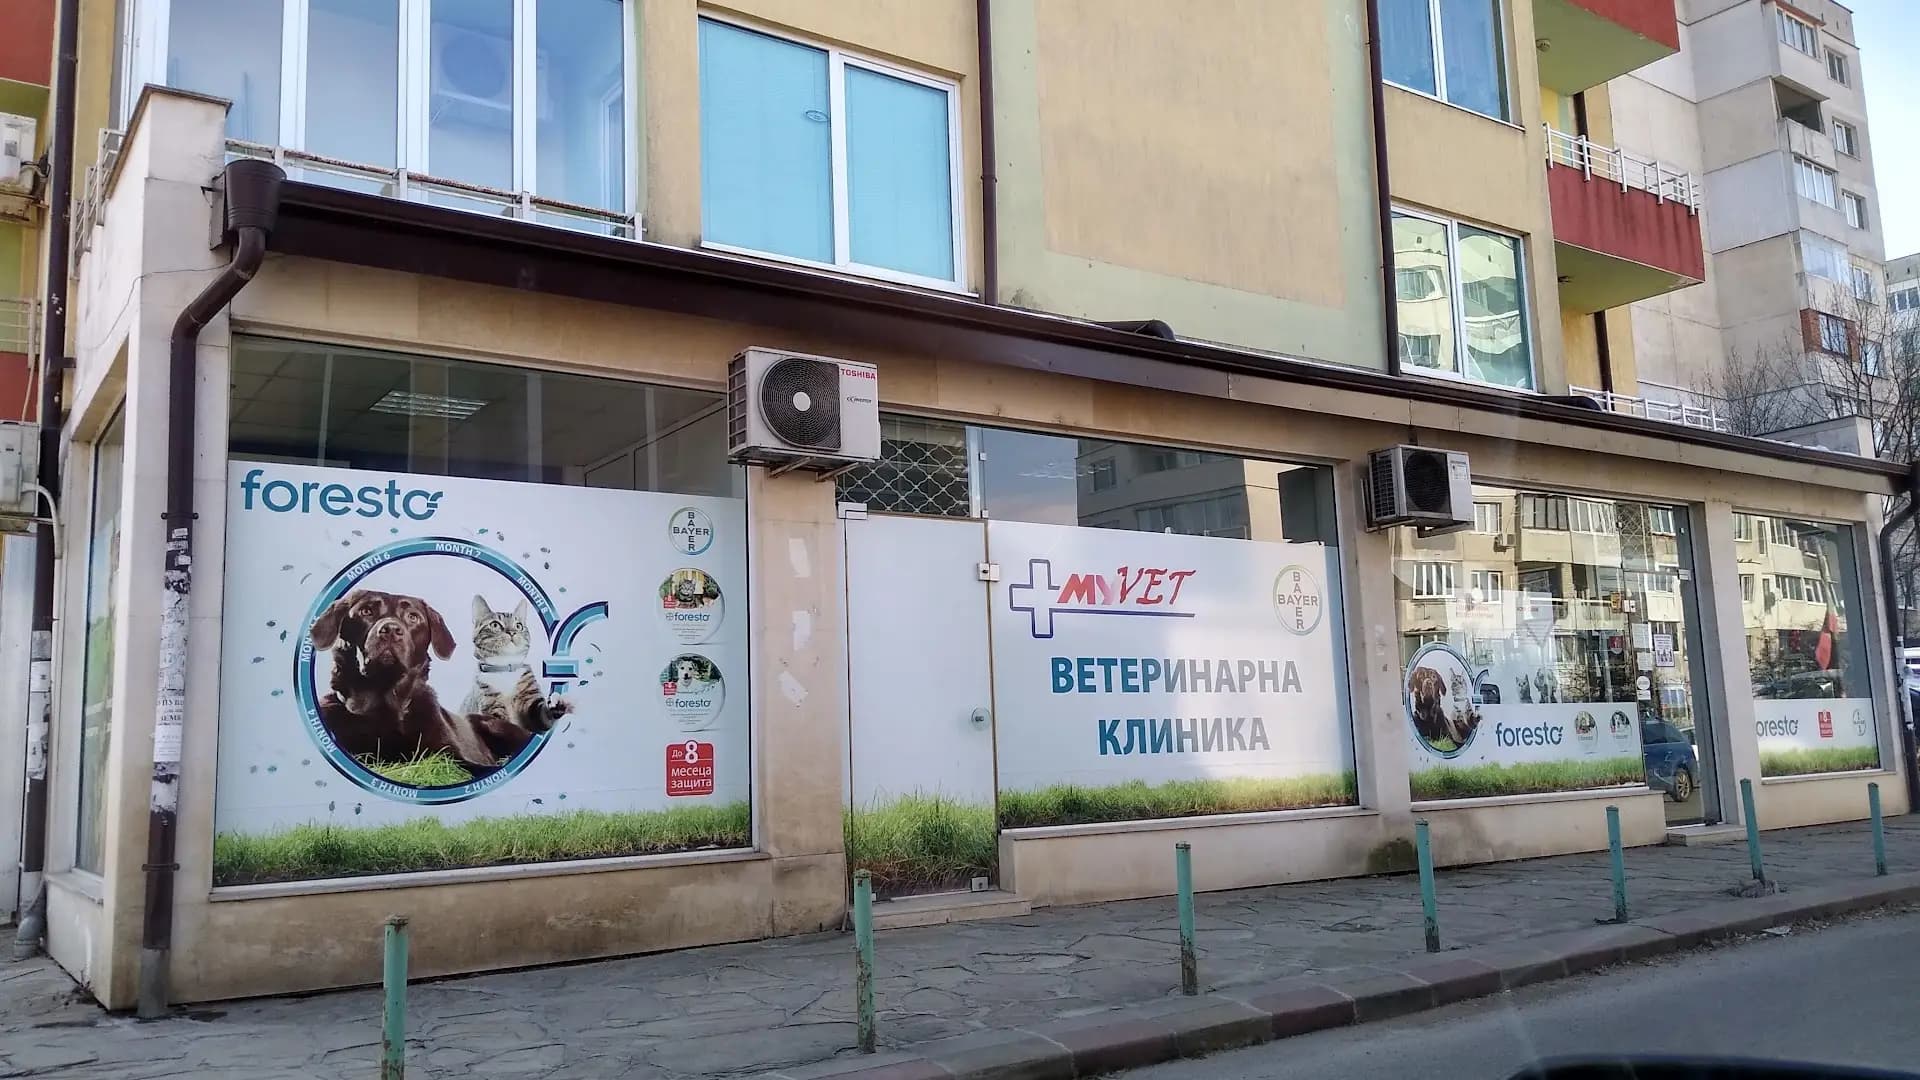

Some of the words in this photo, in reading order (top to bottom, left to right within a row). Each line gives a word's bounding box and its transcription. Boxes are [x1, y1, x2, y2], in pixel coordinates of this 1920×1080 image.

[840, 368, 876, 379] TOSHIBA
[240, 469, 443, 520] foresto
[672, 526, 710, 536] BAYER
[435, 543, 473, 556] MONTH
[346, 554, 383, 581] MONTH
[517, 576, 546, 607] MONTH
[1277, 593, 1319, 607] BAYER
[1293, 571, 1305, 630] BAYER
[674, 612, 711, 622] foresto
[1051, 657, 1303, 693] ВЕТЕРИНАРНА
[675, 698, 712, 708] foresto
[310, 717, 337, 753] MONTH
[1098, 717, 1270, 755] КЛИНИКА
[1496, 722, 1564, 747] foresto
[1755, 714, 1799, 737] oresto
[671, 749, 683, 759] До
[684, 741, 699, 764] 8
[472, 768, 508, 791] MONTH
[671, 766, 712, 777] месеца
[379, 781, 418, 798] MONTH
[671, 778, 712, 789] защита
